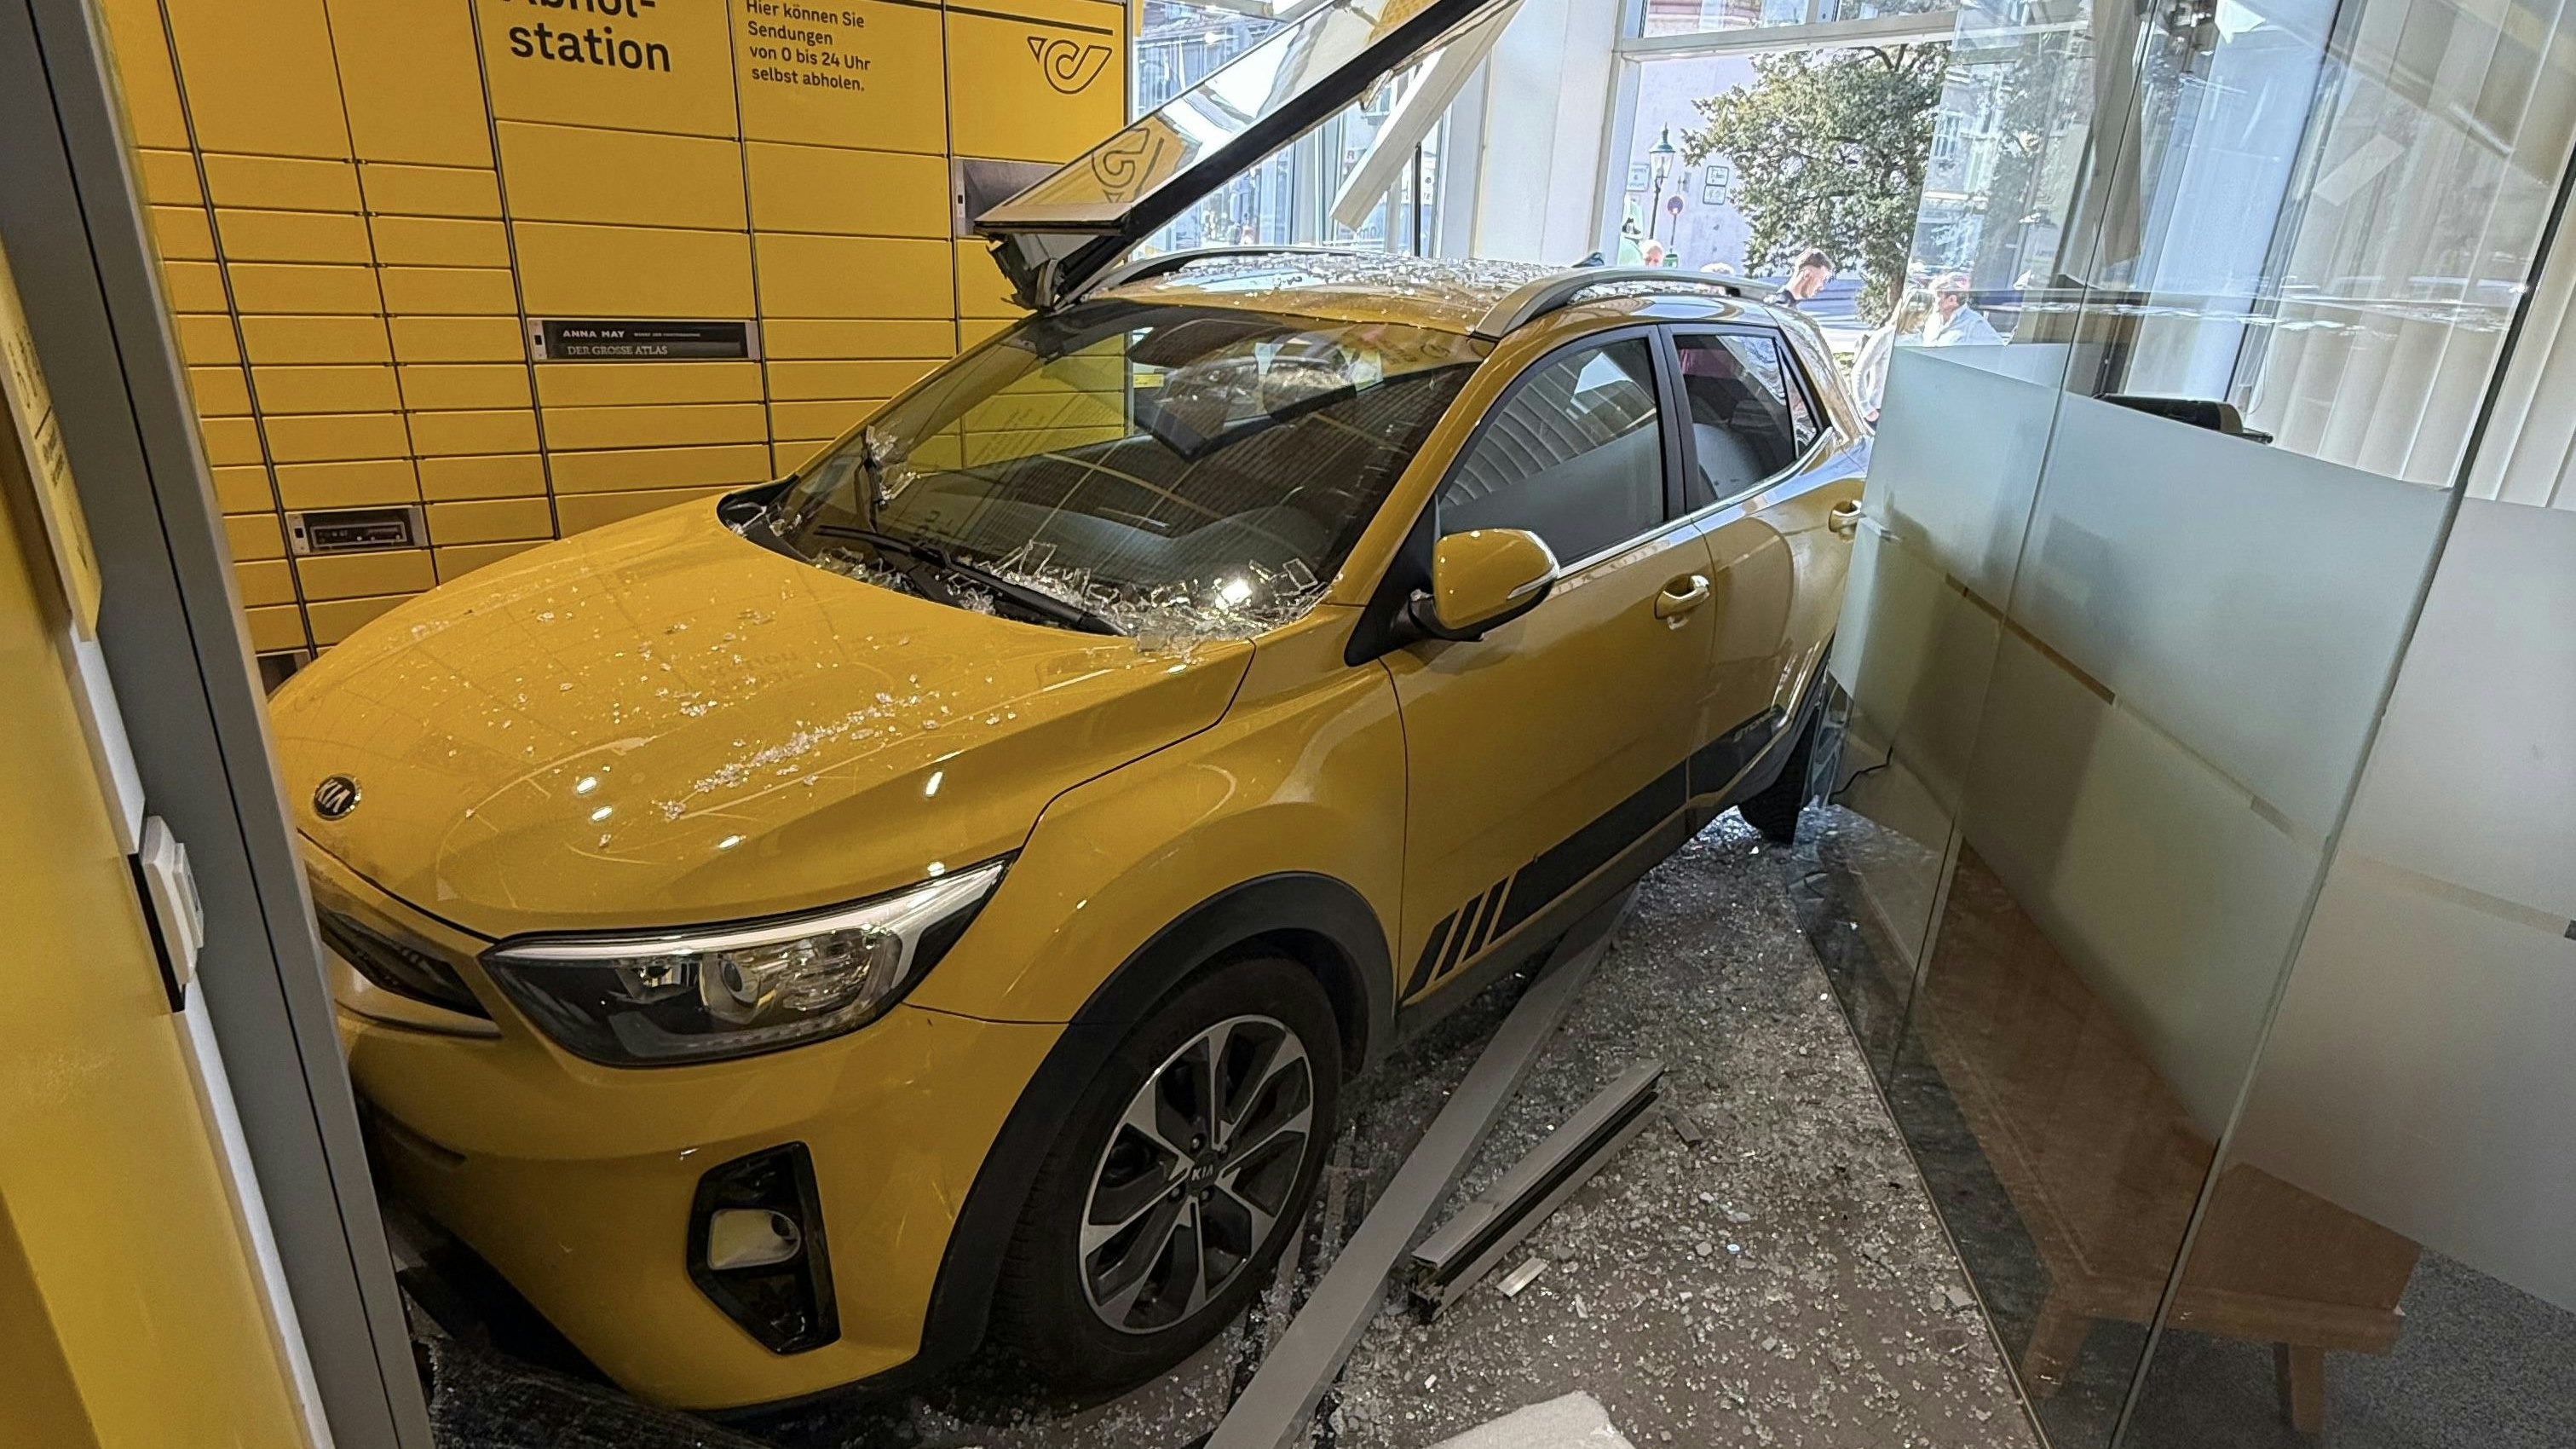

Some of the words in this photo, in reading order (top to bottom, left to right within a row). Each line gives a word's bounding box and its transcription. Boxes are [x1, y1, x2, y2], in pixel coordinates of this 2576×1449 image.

[746, 0, 779, 16] Hier
[783, 3, 838, 24] können
[842, 11, 865, 27] Sie
[748, 20, 833, 46] Sendungen
[509, 23, 671, 72] station
[750, 46, 777, 60] von
[781, 47, 792, 61] 0
[796, 49, 818, 65] bis
[821, 52, 840, 67] 24
[844, 54, 871, 70] Uhr
[752, 67, 798, 84] selbst
[803, 72, 865, 91] abholen.
[562, 330, 596, 338] ANNA
[601, 330, 625, 338] MAY
[567, 345, 591, 355] DER
[592, 345, 632, 355] GROSSE
[635, 345, 668, 355] ATLAS
[315, 778, 351, 813] KIA
[1191, 1163, 1213, 1181] KIA
